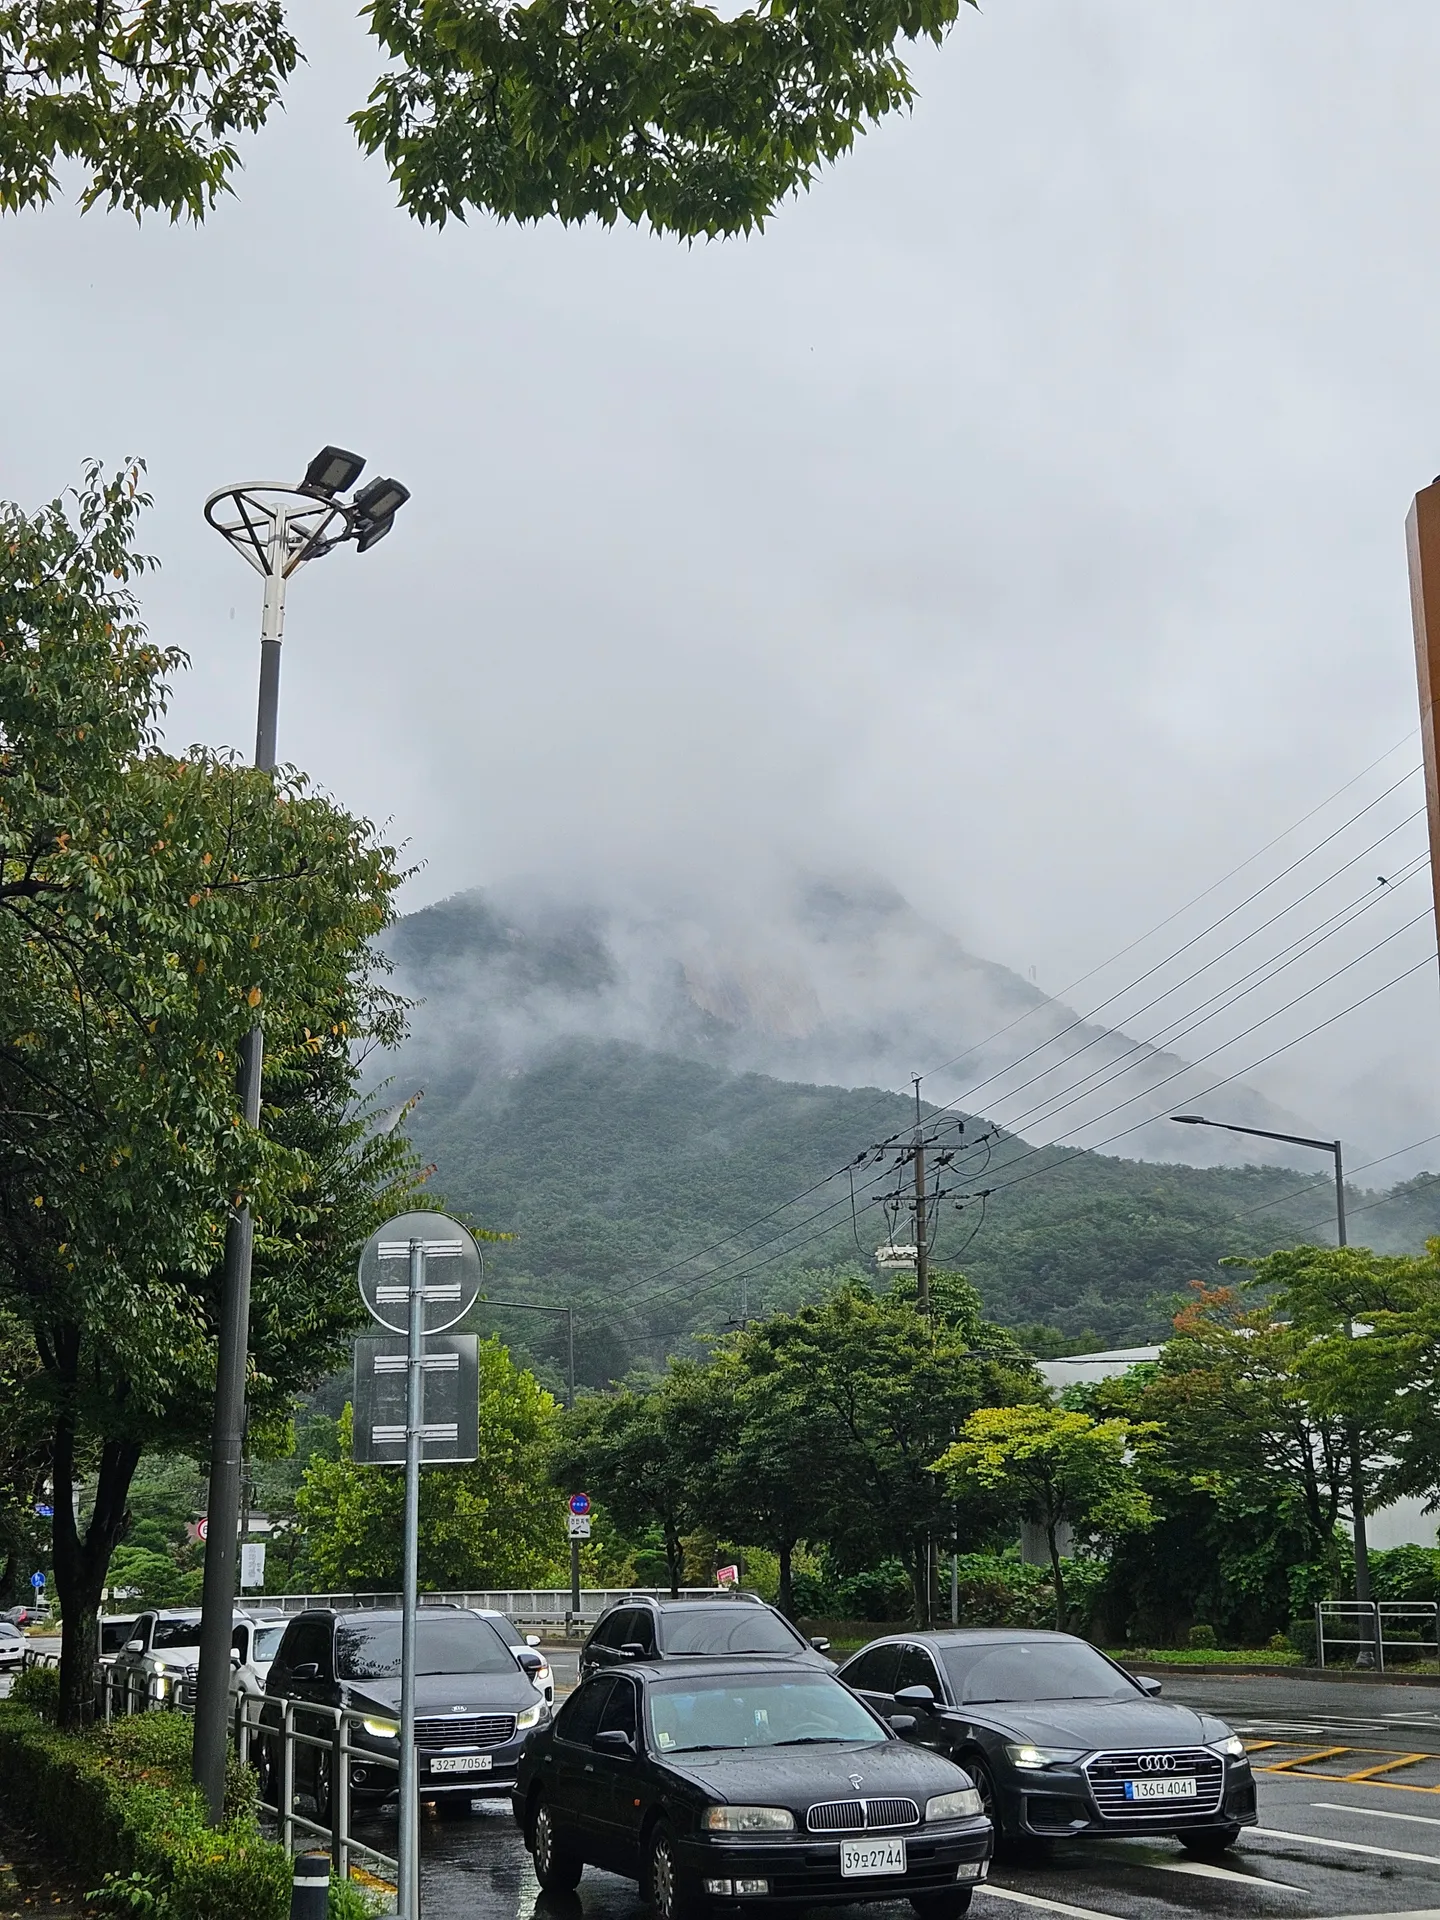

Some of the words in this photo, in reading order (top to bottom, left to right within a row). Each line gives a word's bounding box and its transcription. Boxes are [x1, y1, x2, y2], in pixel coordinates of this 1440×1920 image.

[436, 1760, 456, 1770] 32구
[461, 1758, 487, 1769] 7056
[1167, 1781, 1193, 1796] 4041
[845, 1849, 902, 1869] 39모2744
